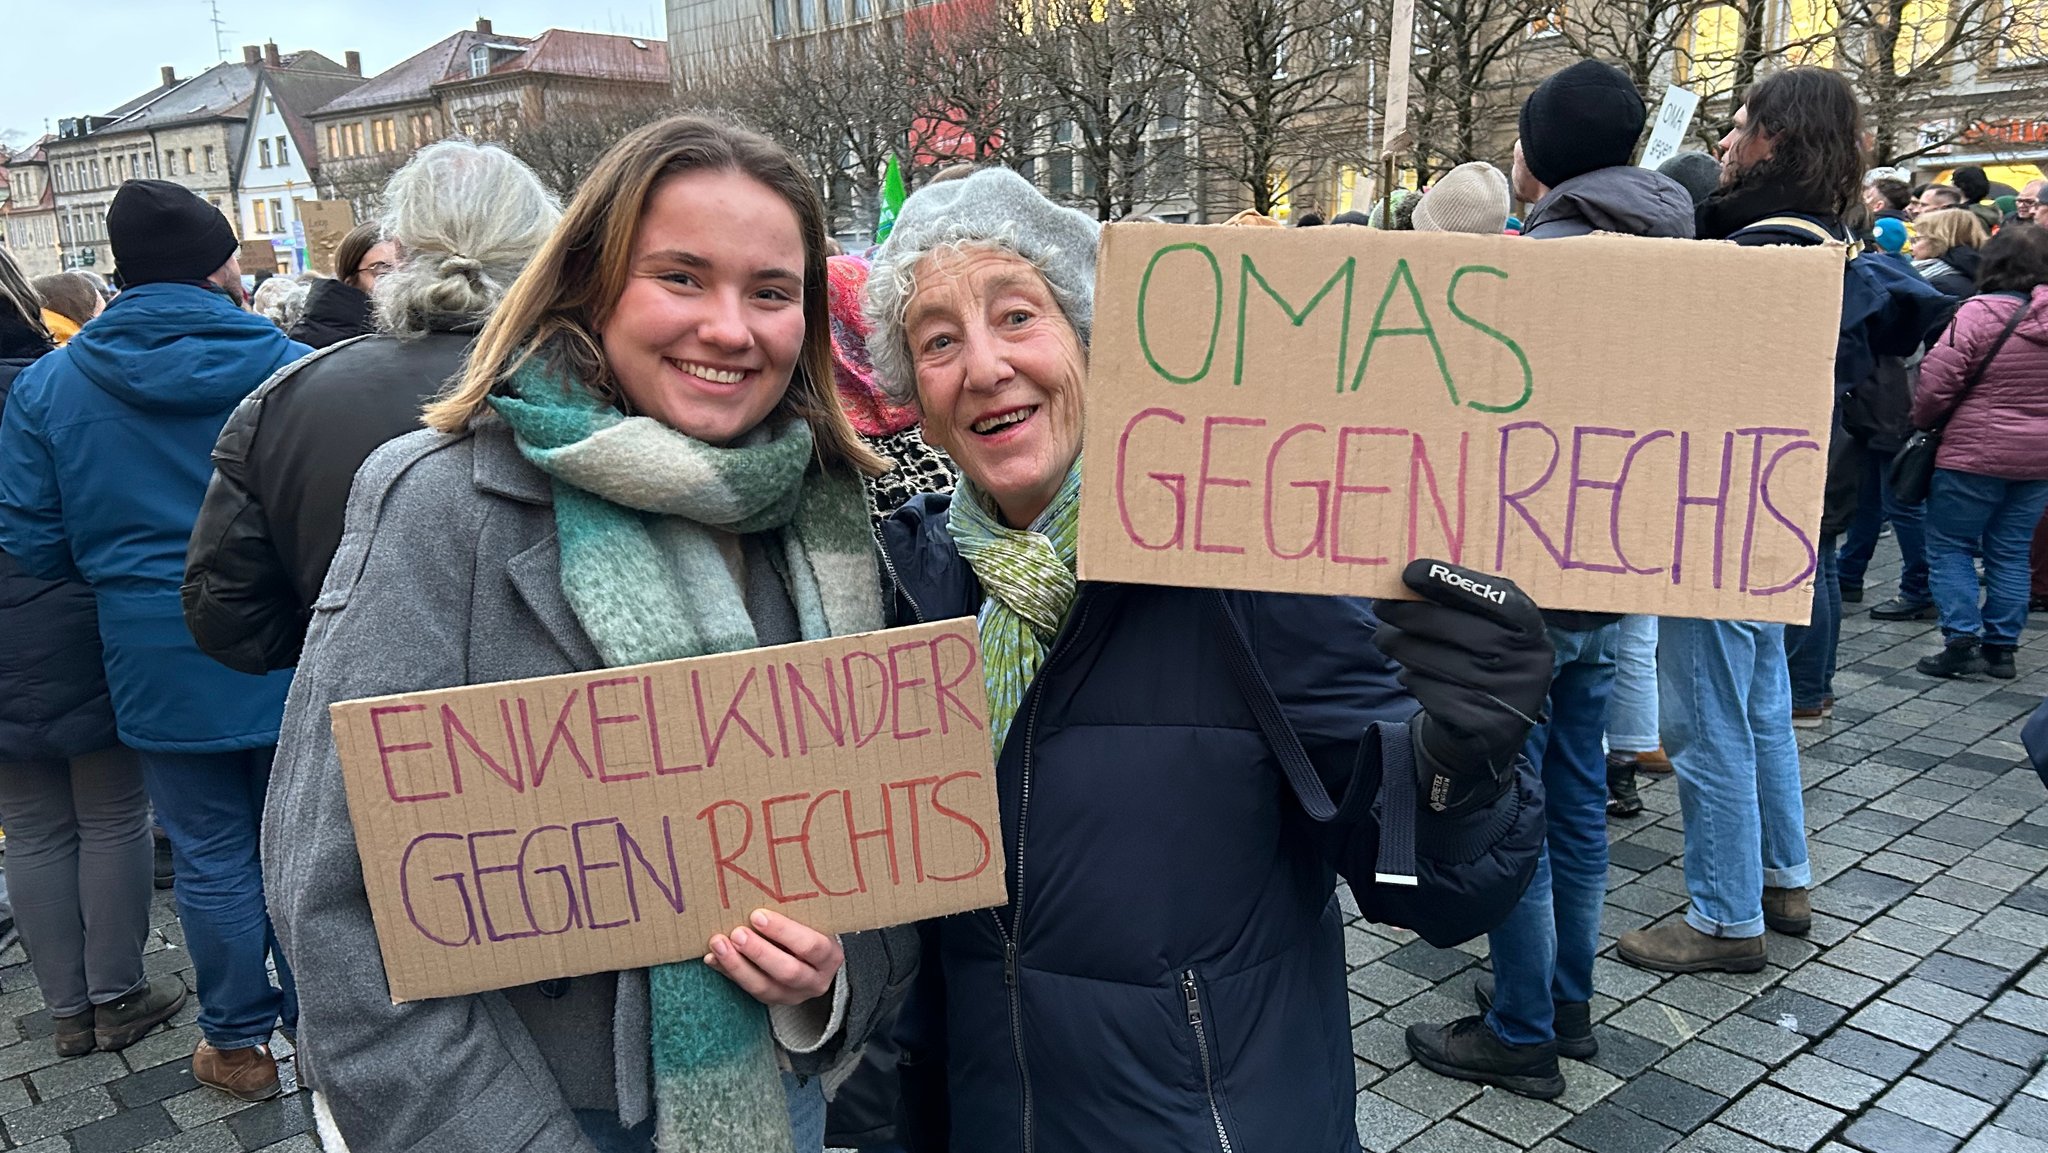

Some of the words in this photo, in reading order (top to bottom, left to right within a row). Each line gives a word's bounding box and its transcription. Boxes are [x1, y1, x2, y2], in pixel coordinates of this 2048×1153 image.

[1137, 242, 1533, 413] OMAS
[1116, 407, 1469, 565] GEGEN
[1495, 420, 1820, 596] RECHTS
[370, 633, 983, 802] ENKELKINDER
[400, 815, 684, 946] GEGEN
[696, 771, 991, 909] RECHTS
